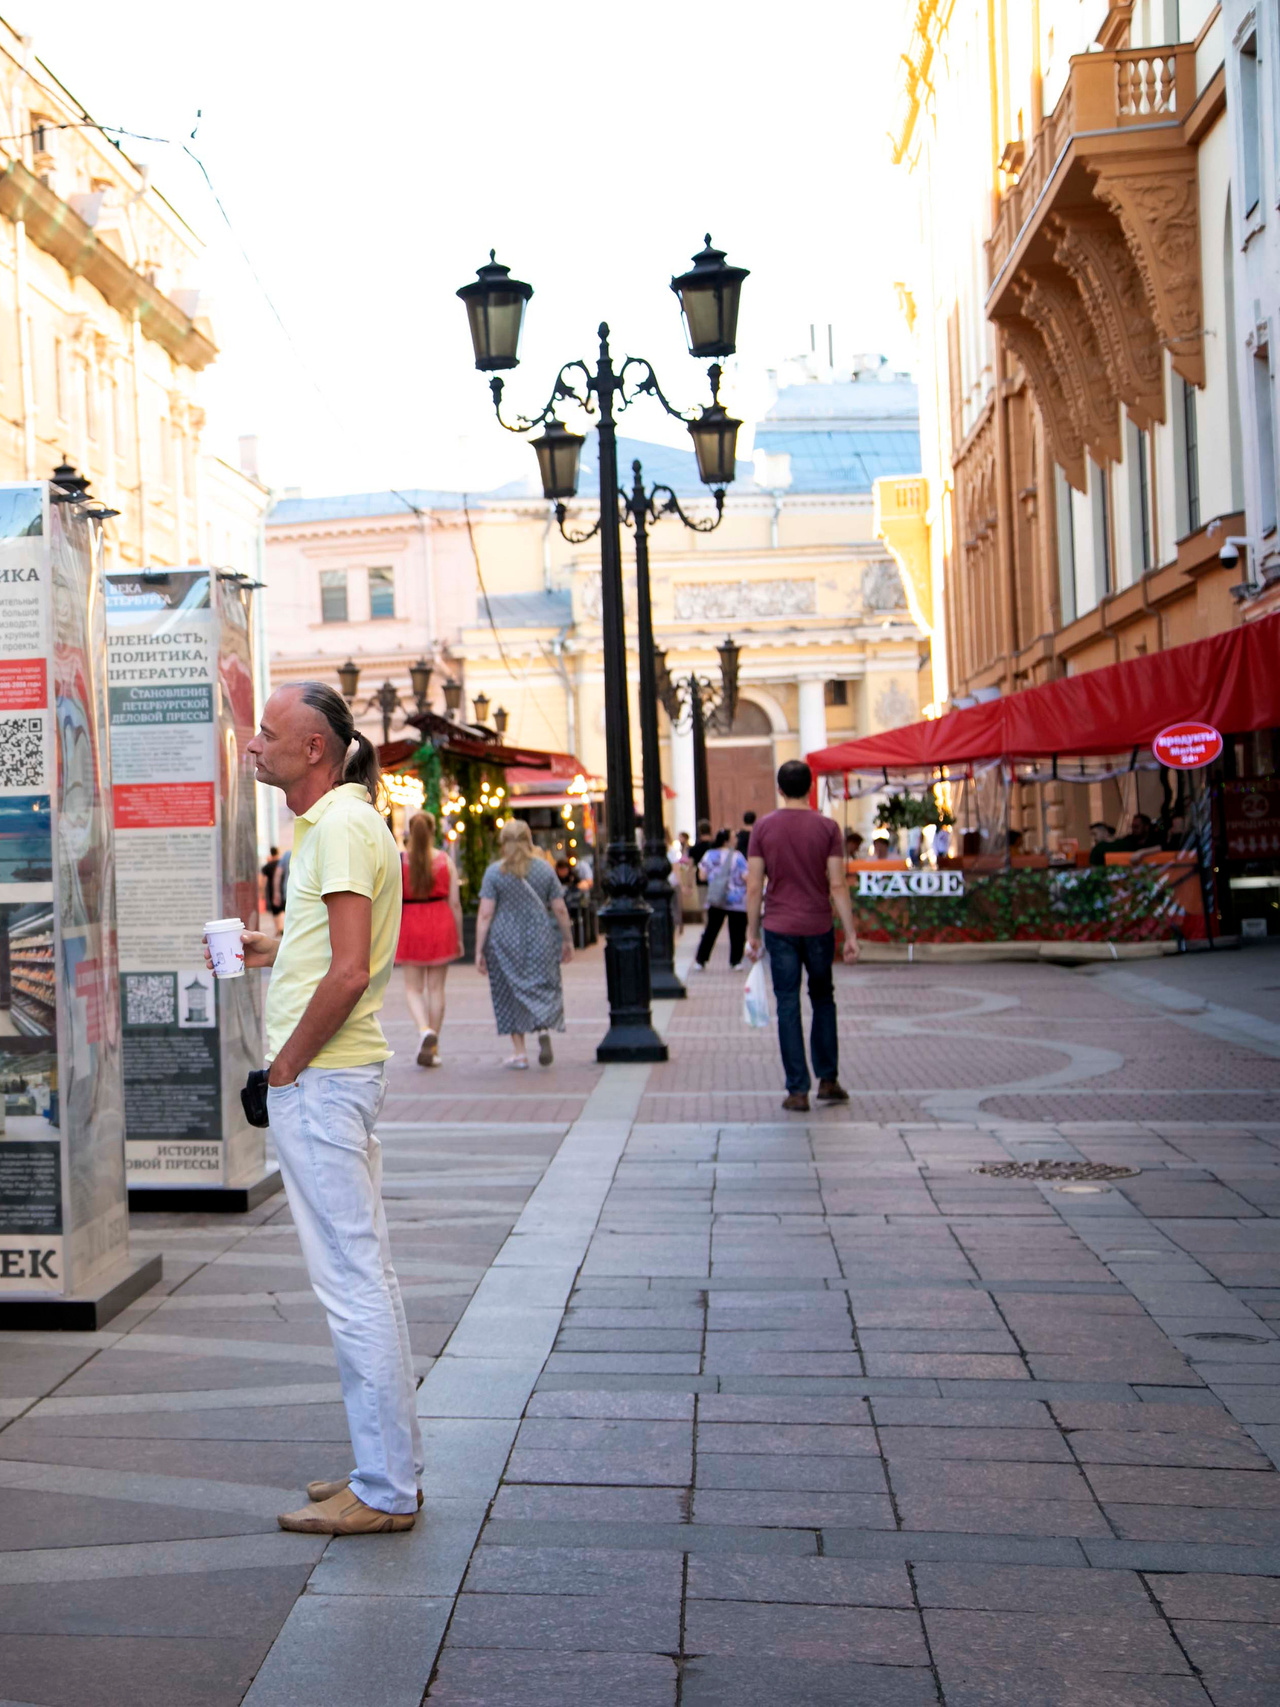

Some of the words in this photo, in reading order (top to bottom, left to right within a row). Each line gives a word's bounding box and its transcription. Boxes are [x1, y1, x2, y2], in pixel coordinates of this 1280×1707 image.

[110, 584, 142, 594] ВЕКА
[106, 594, 172, 606] ЕТЕРБУРГА
[110, 649, 208, 664] ПОЛИТИКА,
[122, 698, 210, 711] ПЕТЕРБУРГСКОЙ
[112, 712, 162, 724] ДЕЛОВОЙ
[166, 712, 210, 722] ПРЕССЫ
[858, 871, 964, 896] КАФЕ
[158, 1146, 219, 1156] ИСТОРИЯ
[166, 1160, 220, 1170] ПРЕССЫ
